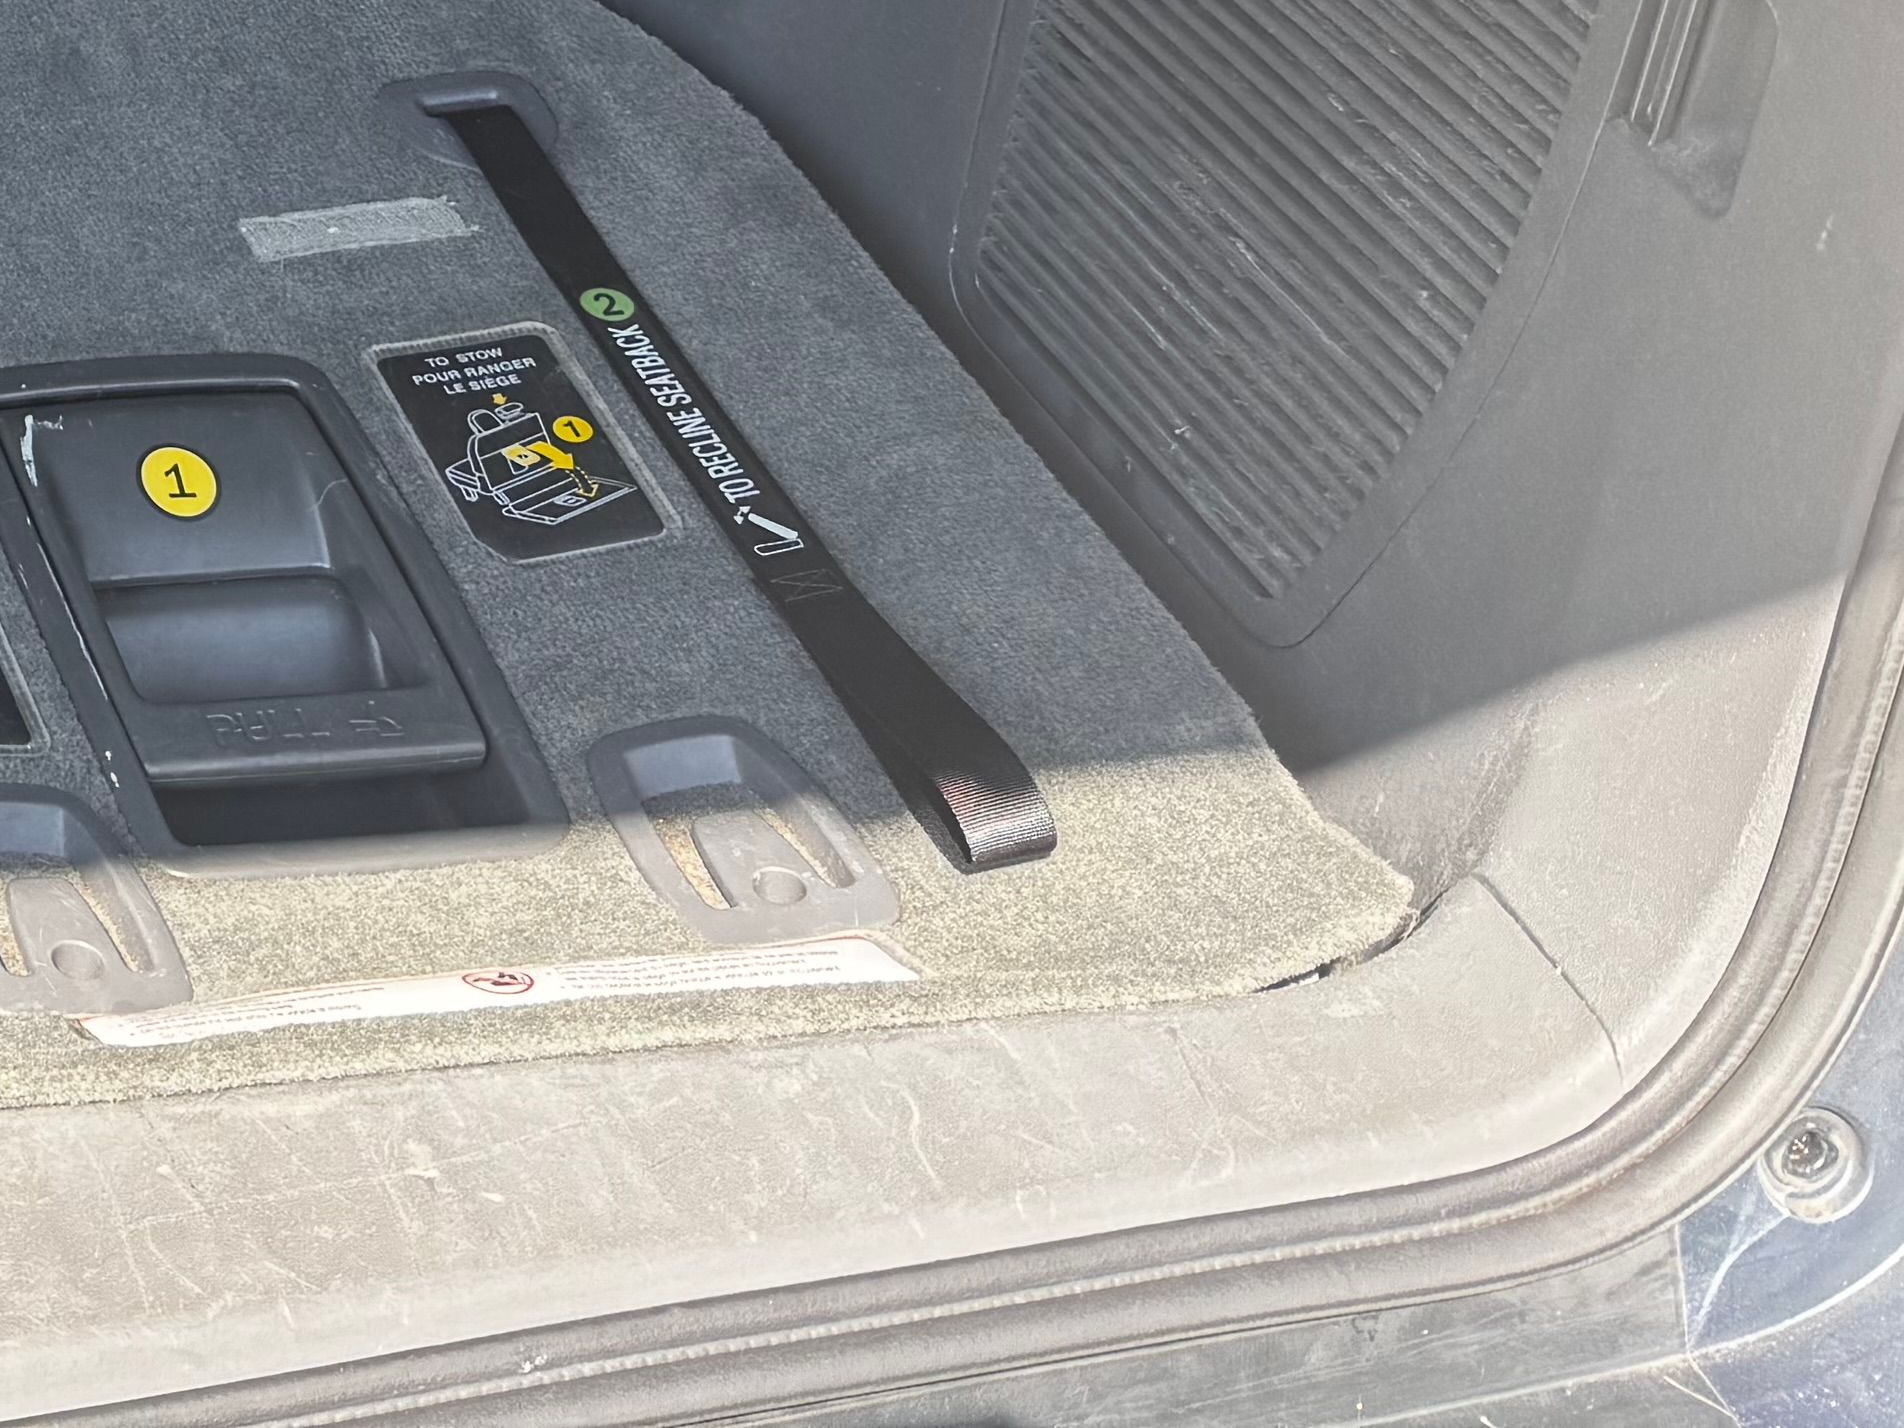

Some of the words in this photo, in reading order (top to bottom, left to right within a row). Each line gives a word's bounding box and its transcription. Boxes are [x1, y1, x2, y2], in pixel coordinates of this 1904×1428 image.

[592, 292, 625, 317] 2
[412, 369, 462, 386] POUR
[463, 357, 537, 377] RANGER
[424, 356, 450, 368] TO
[455, 347, 503, 363] STOW
[607, 323, 693, 408] SEATBACK
[443, 382, 467, 395] LE
[564, 420, 580, 438] 1
[666, 407, 744, 480] RECLINE
[163, 462, 197, 498] 1
[718, 477, 761, 505] TO
[204, 707, 331, 747] PULL
